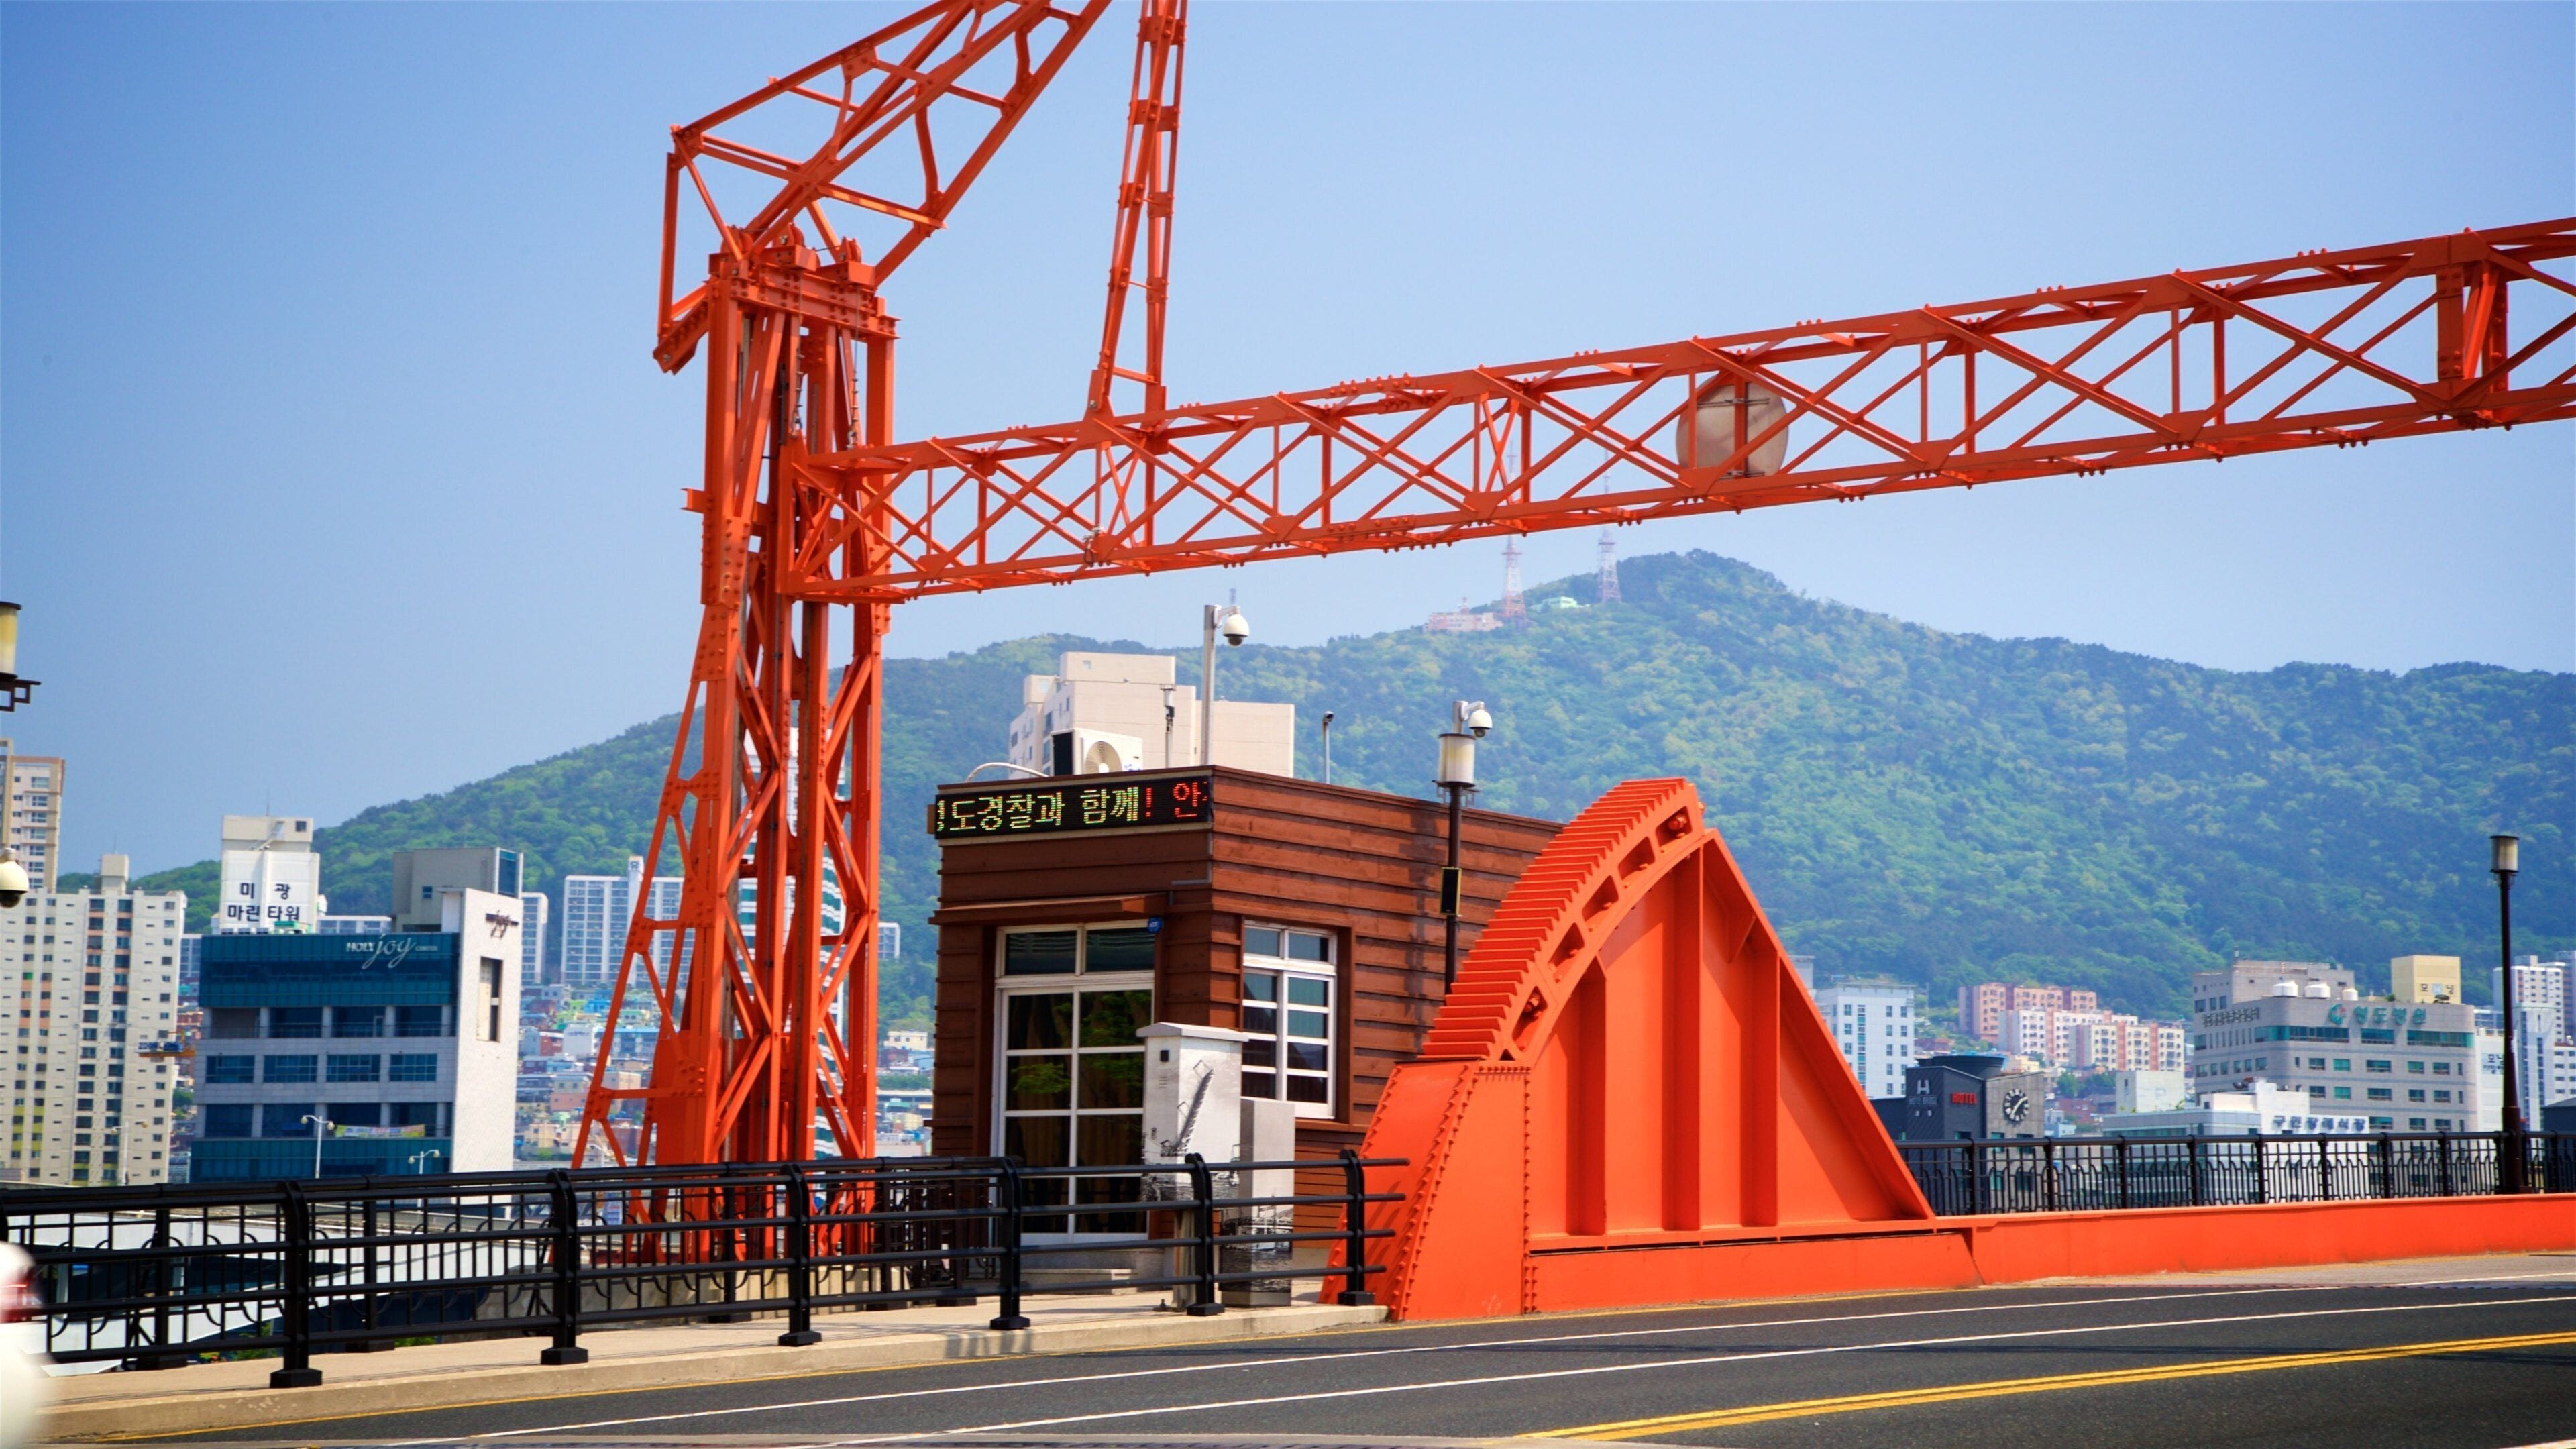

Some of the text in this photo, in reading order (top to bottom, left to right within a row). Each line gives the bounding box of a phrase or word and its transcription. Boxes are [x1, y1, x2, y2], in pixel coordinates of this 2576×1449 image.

[346, 942, 374, 952] HOLY
[361, 934, 417, 969] joy
[1951, 1092, 1978, 1105] HOTEL
